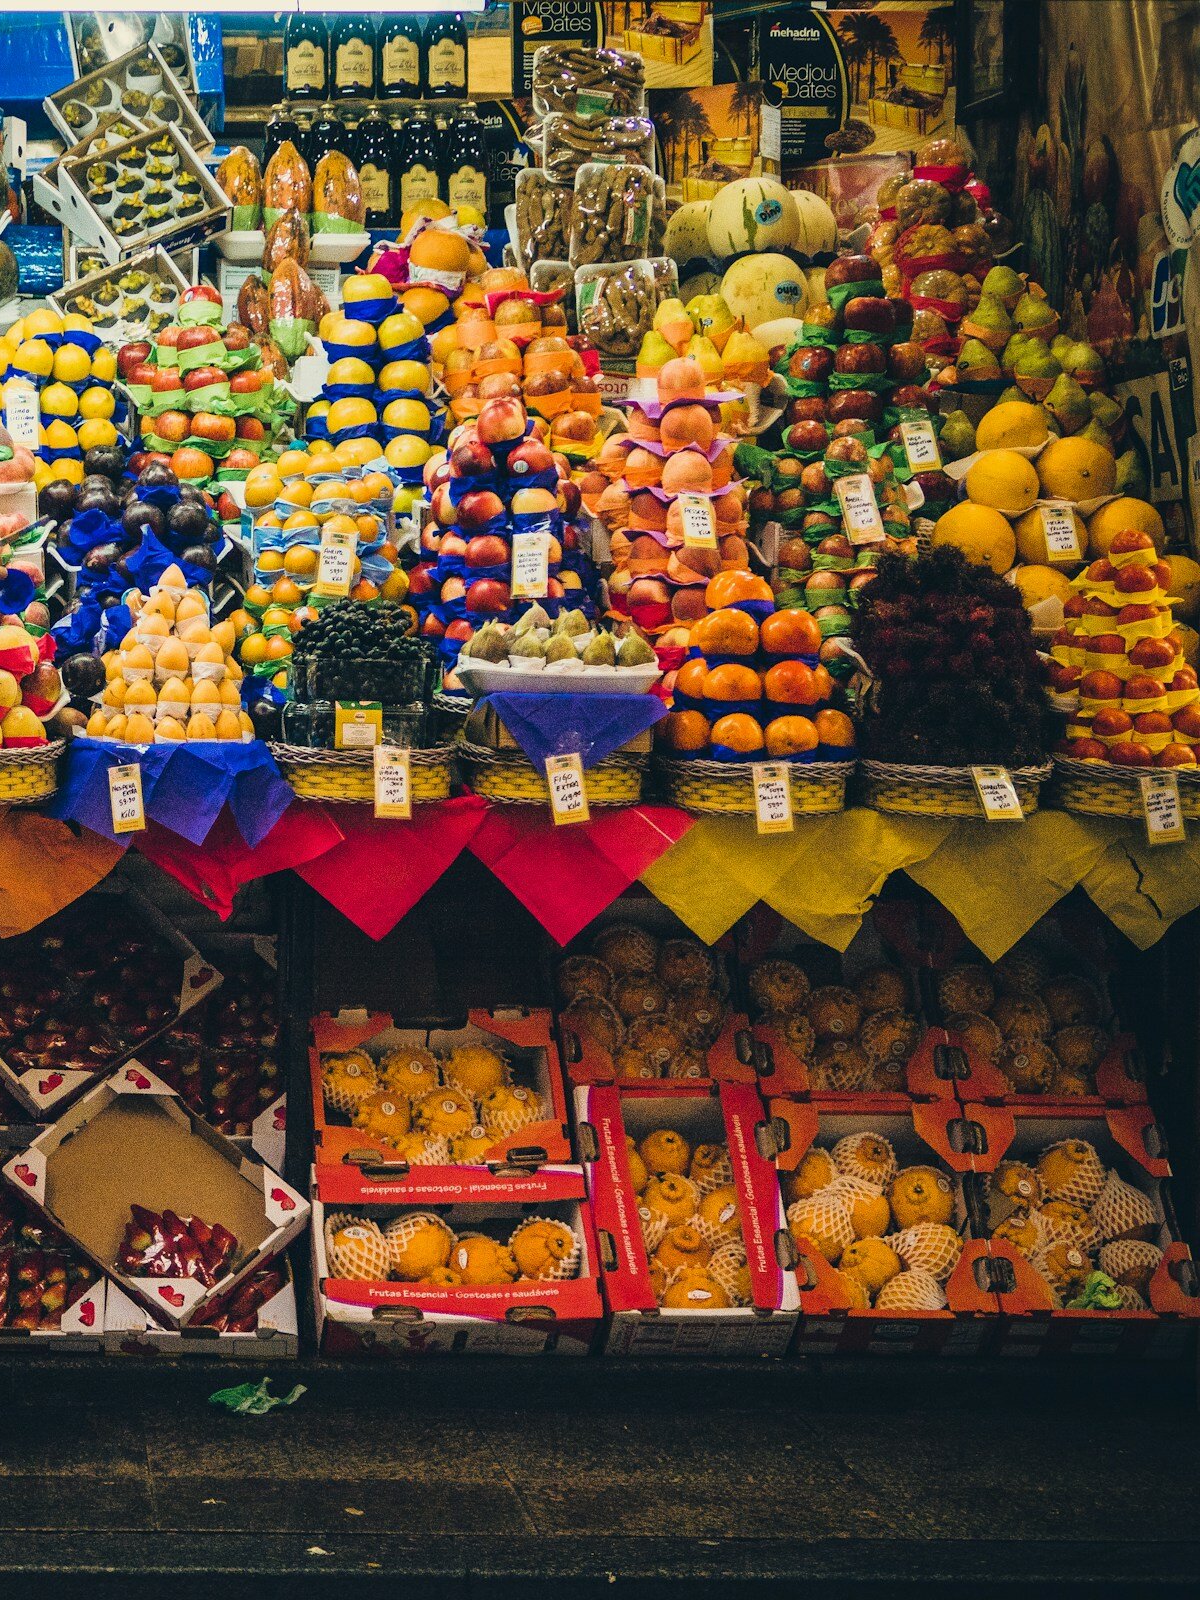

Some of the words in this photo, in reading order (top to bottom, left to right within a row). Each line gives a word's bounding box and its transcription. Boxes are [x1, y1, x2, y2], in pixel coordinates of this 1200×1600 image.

[541, 15, 591, 33] Dates
[770, 28, 820, 38] mehadrin
[769, 63, 837, 86] Medjoul
[785, 81, 836, 99] Dates
[759, 205, 782, 221] Dino
[123, 789, 138, 797] EXTRA
[557, 781, 579, 791] EXTRA
[602, 1117, 613, 1145] Frutas
[731, 1114, 746, 1154] saudáveis
[606, 1145, 622, 1183] Essencial
[469, 1183, 514, 1193] Essencial
[514, 1182, 547, 1191] Frutas
[741, 1159, 755, 1200] Gostosas
[360, 1186, 407, 1195] saudáveis
[415, 1184, 462, 1194] Gostosas
[614, 1188, 628, 1229] Gostosas
[748, 1206, 763, 1245] Essencial
[623, 1235, 639, 1275] saudáveis
[757, 1247, 768, 1273] Frutas
[369, 1288, 401, 1298] Frutas
[402, 1290, 448, 1299] Essencial
[455, 1291, 502, 1299] Gostosas
[511, 1288, 559, 1298] saudáveis
